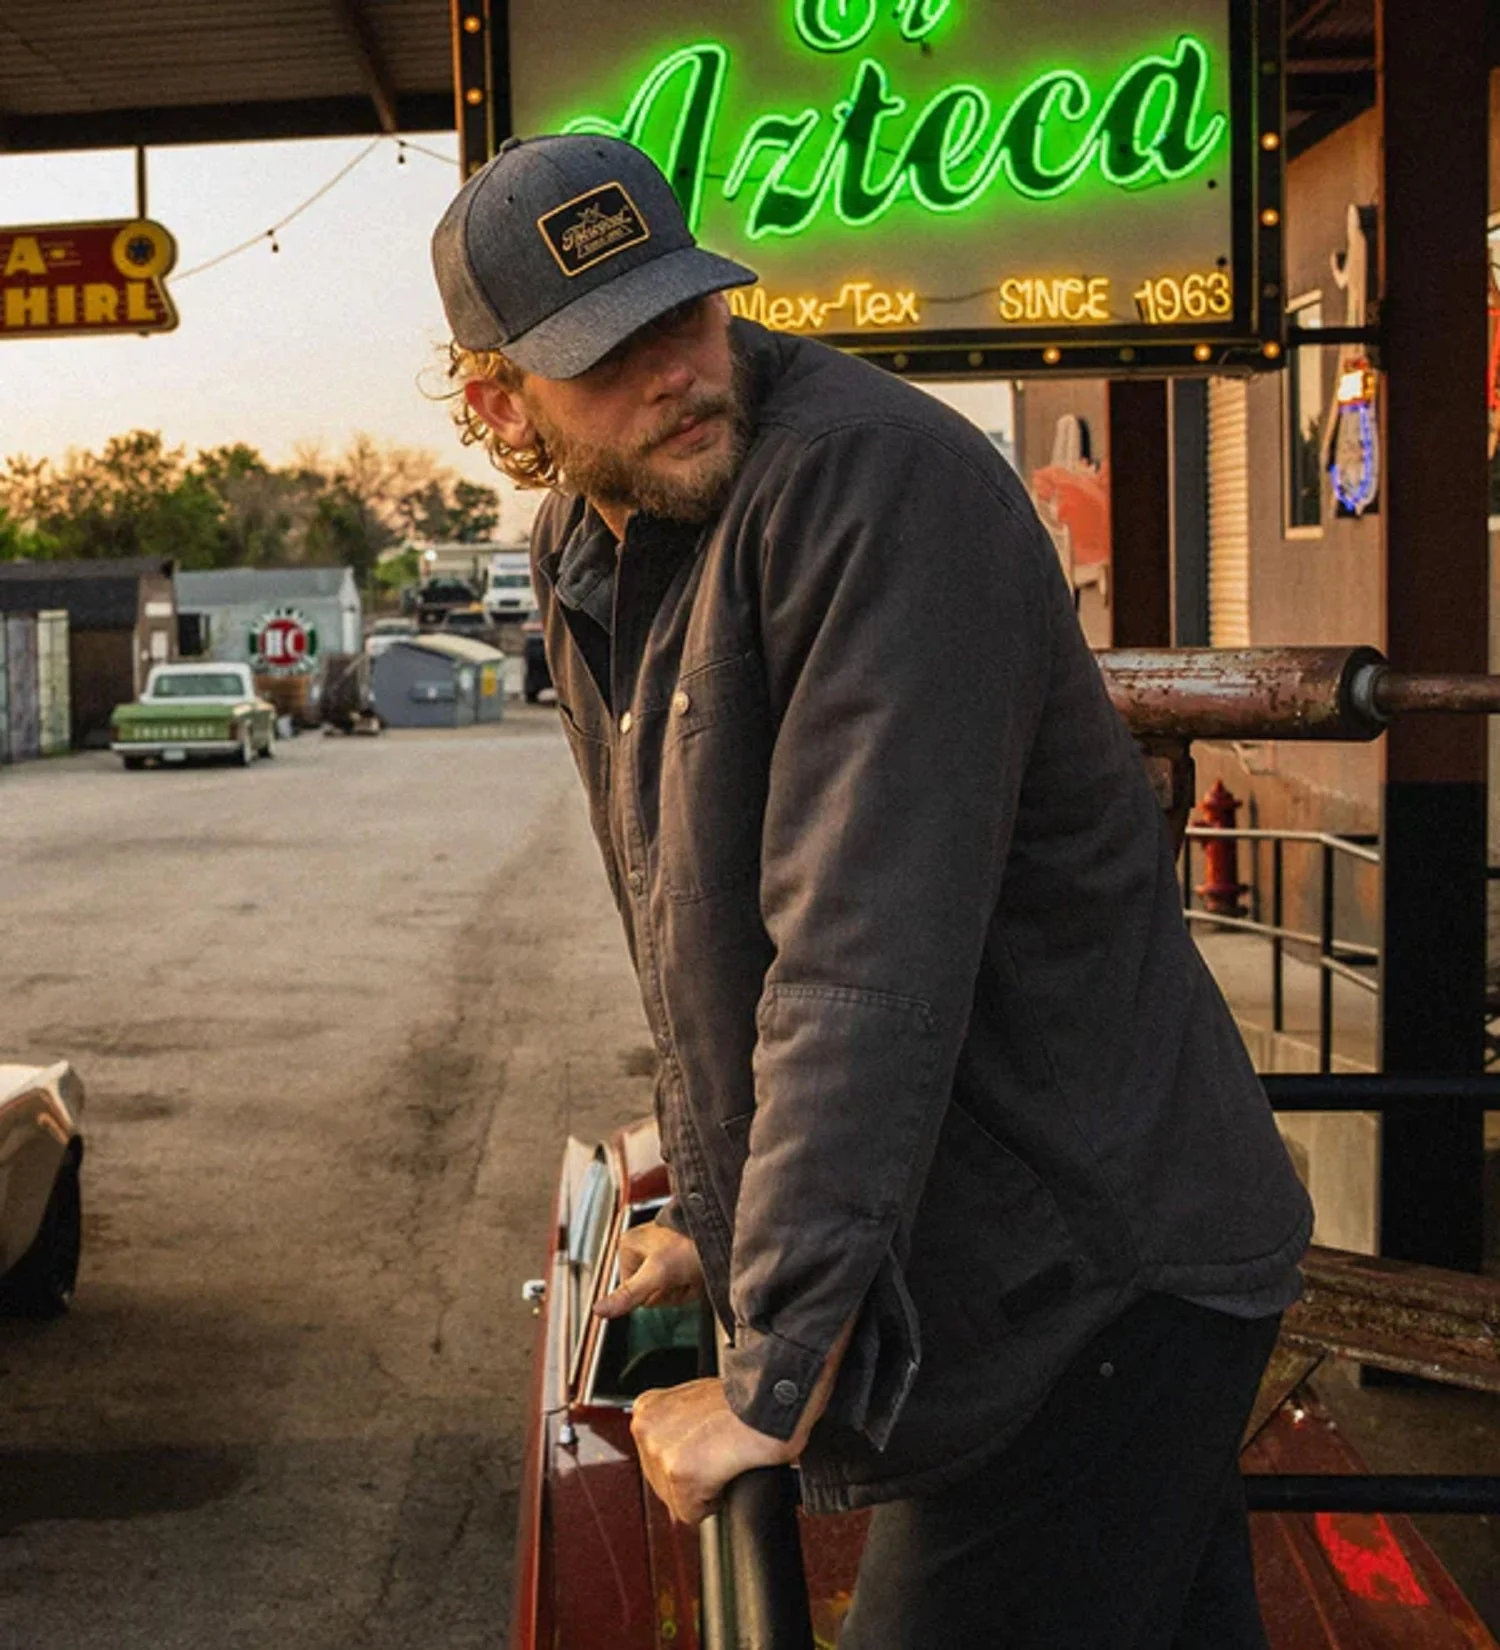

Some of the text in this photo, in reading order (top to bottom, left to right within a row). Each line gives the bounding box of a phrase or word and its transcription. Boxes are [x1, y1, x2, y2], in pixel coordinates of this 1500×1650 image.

[559, 36, 1227, 241] Azteca
[1000, 277, 1109, 321] SINCE
[1134, 271, 1230, 324] 1963
